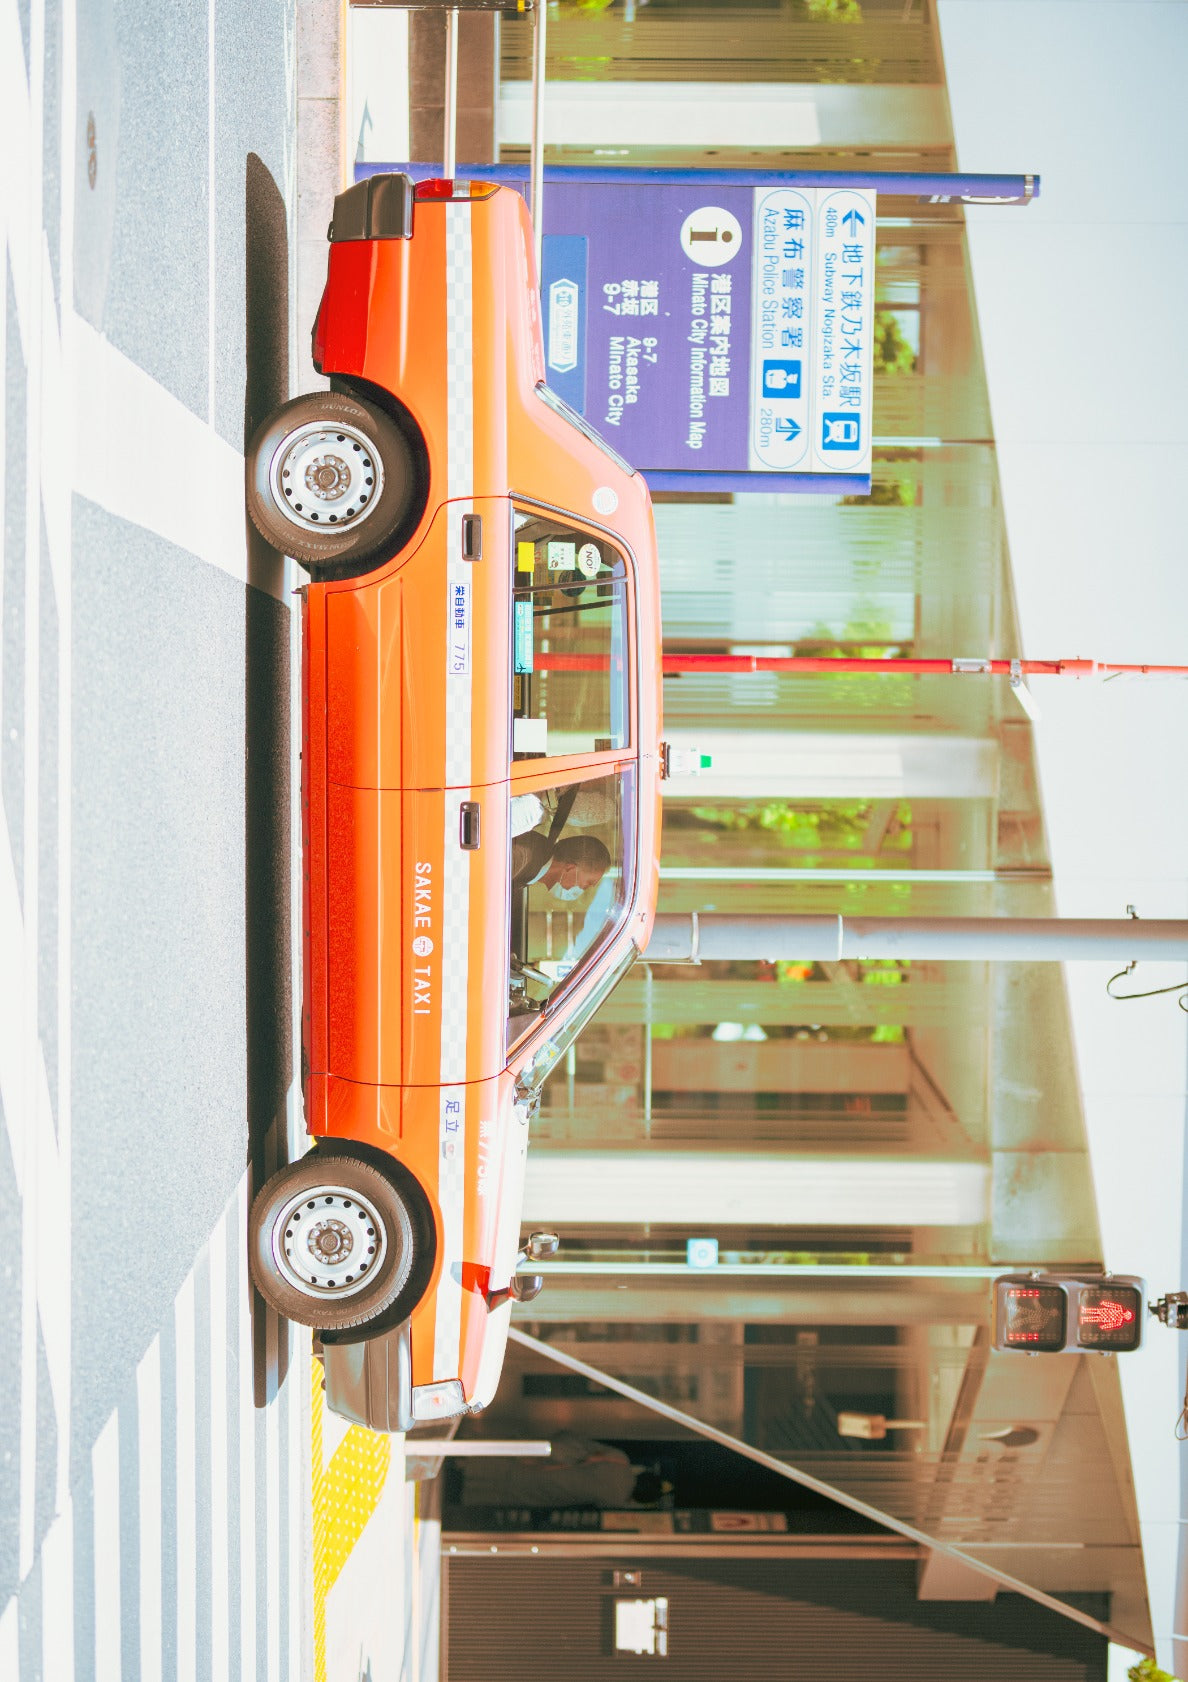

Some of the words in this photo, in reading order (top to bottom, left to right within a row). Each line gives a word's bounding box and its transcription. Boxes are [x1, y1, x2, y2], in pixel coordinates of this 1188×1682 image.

[763, 208, 779, 251] Azabu
[826, 207, 836, 237] 480m
[691, 274, 707, 315] Minato
[763, 256, 778, 294] Police
[781, 208, 804, 348] 麻布警察署
[822, 253, 835, 303] Subway
[603, 284, 620, 315] 9-7
[621, 280, 639, 315] 赤坂
[640, 280, 658, 315] 港区
[688, 319, 707, 343] City
[709, 274, 731, 396] 港区案内地図
[762, 300, 778, 349] Station
[822, 309, 835, 369] Nogizaka
[839, 244, 863, 407] 地下鉄乃木坂駅
[608, 337, 622, 390] Minato
[625, 337, 640, 404] Akasaka
[643, 338, 657, 362] 9-7
[689, 347, 707, 417] Information
[822, 375, 834, 400] Sta.
[605, 394, 622, 426] City
[760, 408, 772, 447] 280m
[686, 422, 705, 449] Map
[455, 586, 465, 629] 栄自動車
[454, 643, 465, 671] 775
[415, 862, 432, 928] SAKAE
[414, 966, 430, 1014] TAXI
[446, 1100, 460, 1132] 足立
